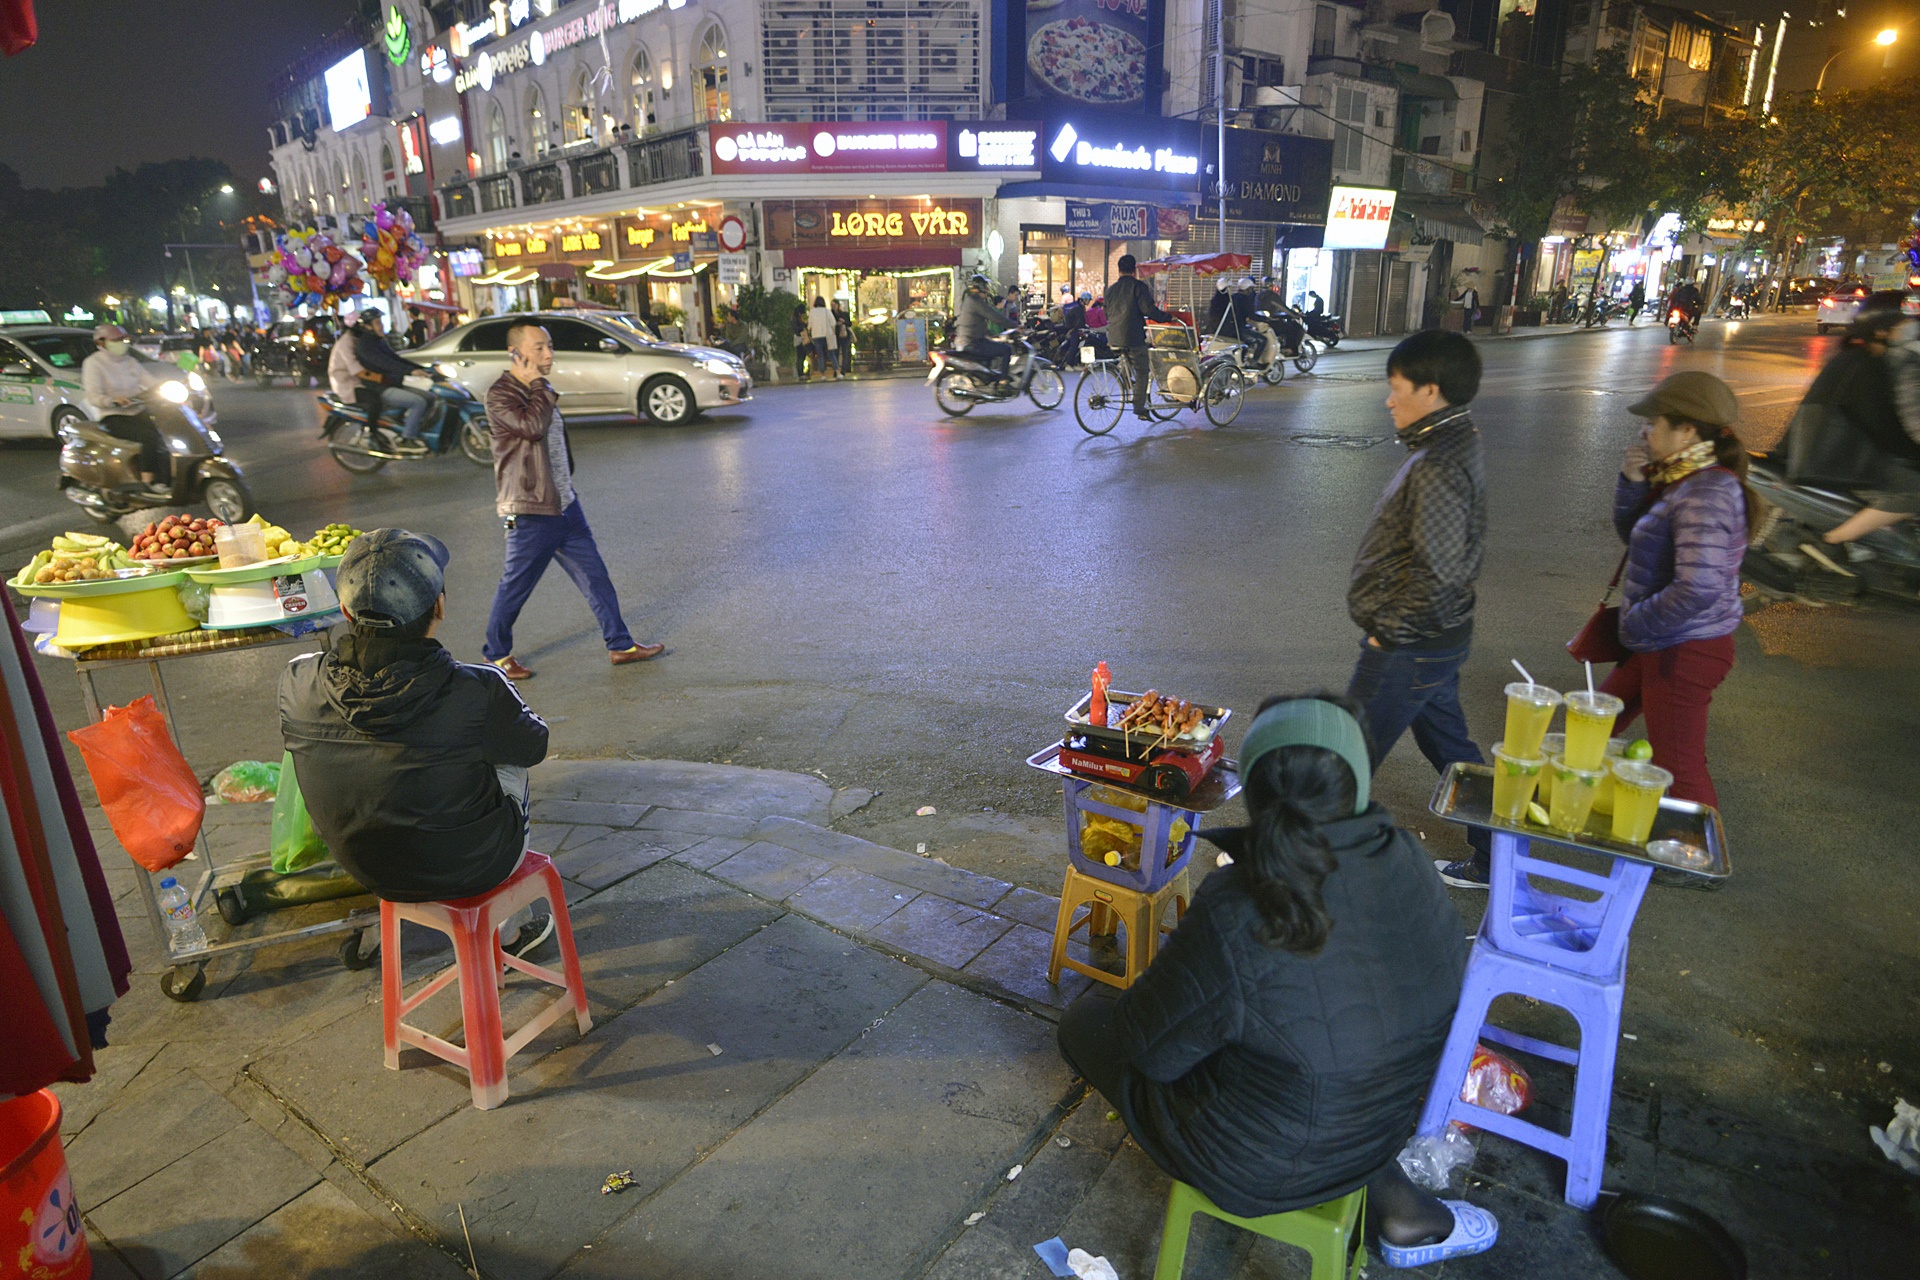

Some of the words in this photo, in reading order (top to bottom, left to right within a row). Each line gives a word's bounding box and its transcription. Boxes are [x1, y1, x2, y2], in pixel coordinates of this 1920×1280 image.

[543, 17, 586, 55] BURGER
[1154, 147, 1198, 175] Pizza
[1260, 163, 1283, 175] MINH
[1240, 180, 1301, 203] DIAMOND
[830, 212, 904, 237] LONG
[910, 206, 969, 236] VÂN
[1110, 205, 1137, 222] MUA
[284, 601, 306, 609] CRAVEN
[1071, 757, 1104, 772] NaMilux
